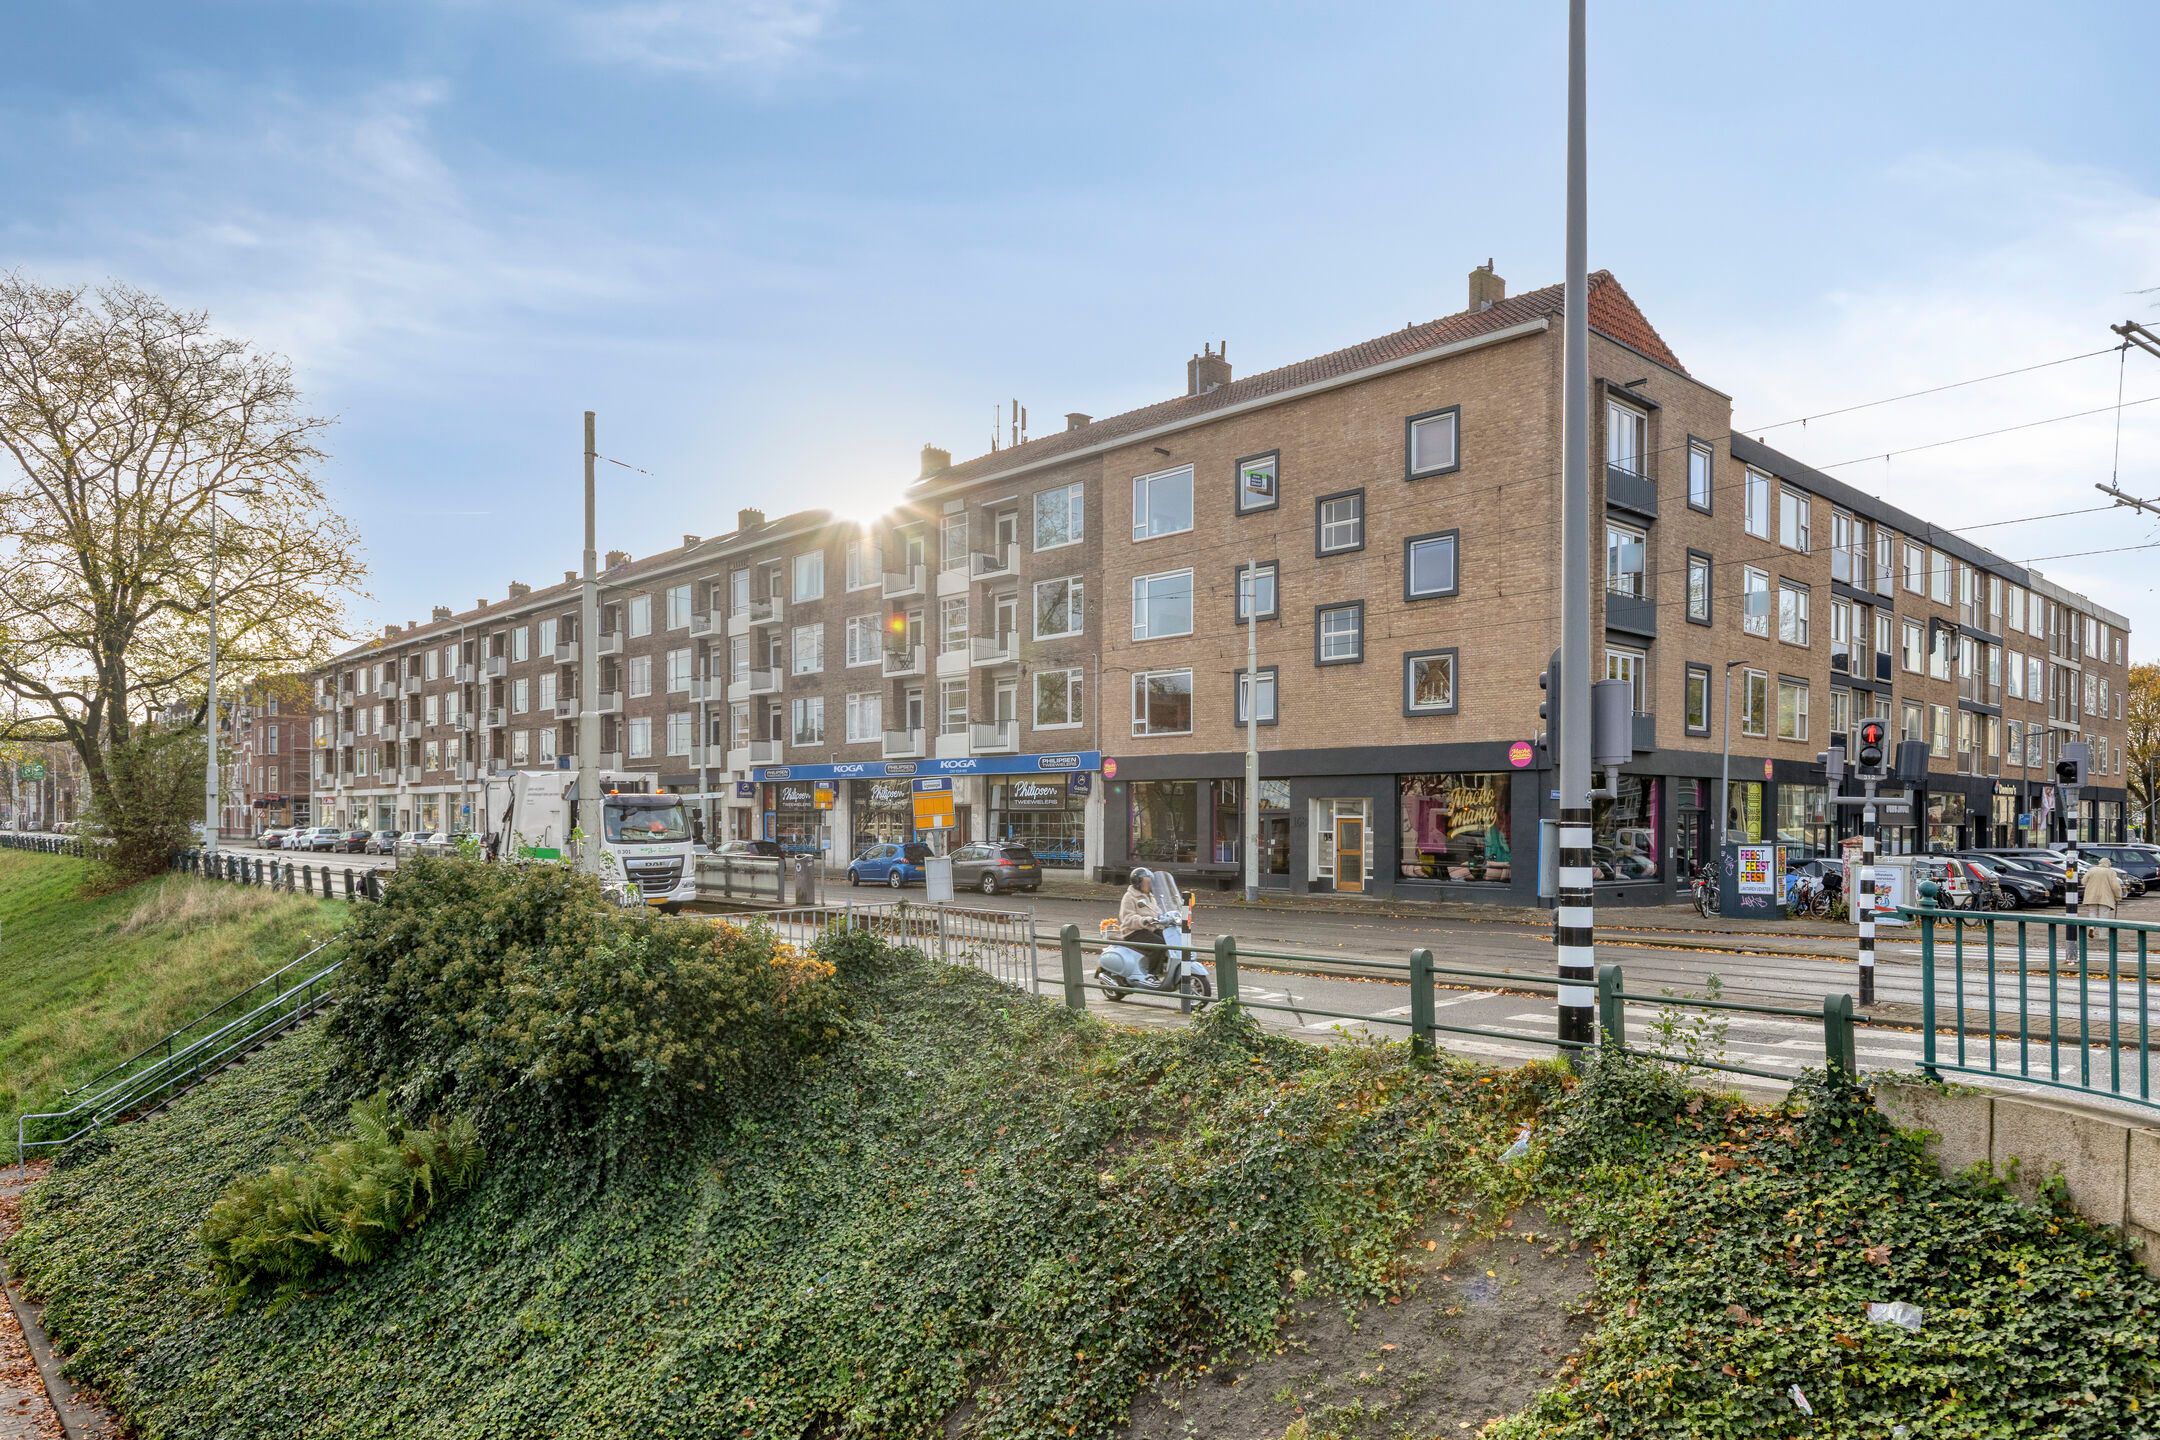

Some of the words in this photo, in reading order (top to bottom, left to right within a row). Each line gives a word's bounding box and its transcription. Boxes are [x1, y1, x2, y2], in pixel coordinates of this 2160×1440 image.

[940, 760, 976, 768] KOGA
[782, 787, 811, 802] Philipsen
[871, 784, 905, 801] Philipsen
[1014, 781, 1057, 799] Philipsen
[1448, 787, 1495, 816] Macho
[1452, 806, 1497, 828] mama
[1741, 850, 1765, 860] FEEST
[1746, 861, 1770, 871] FEEST
[1741, 872, 1765, 882] FEEST
